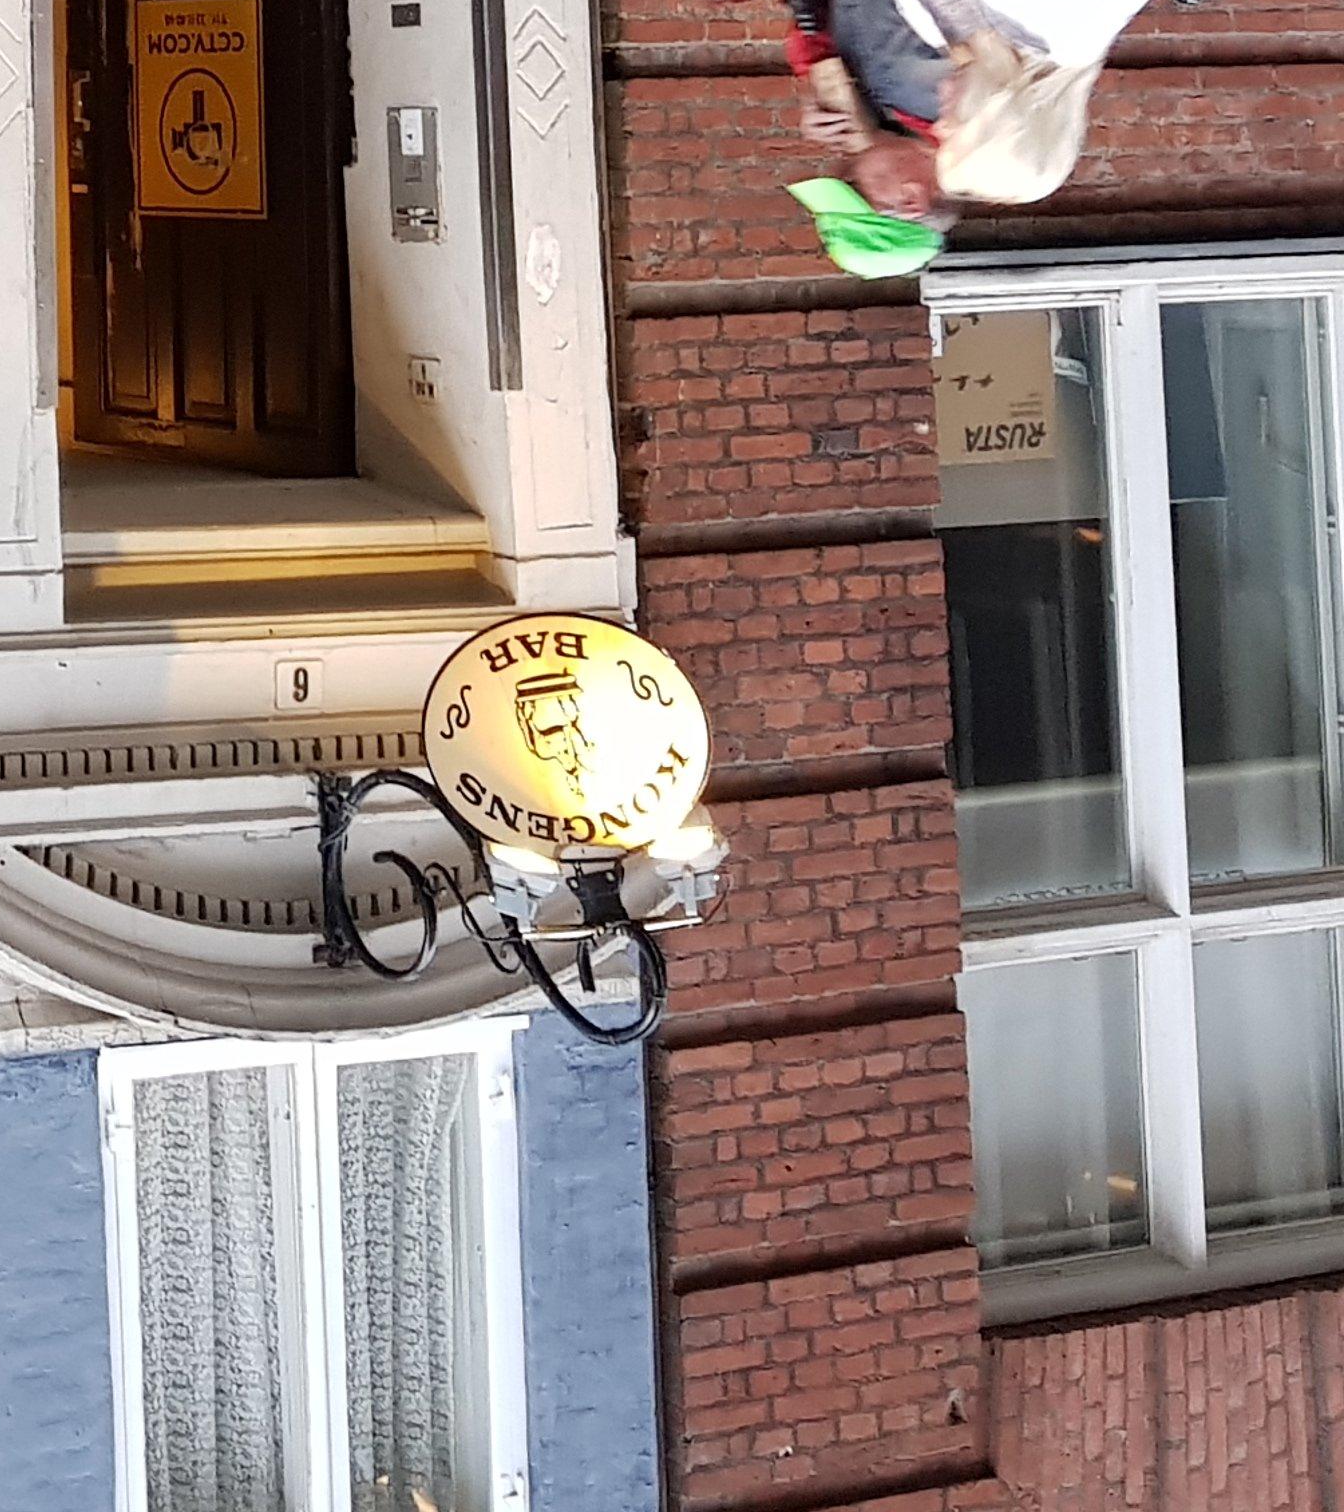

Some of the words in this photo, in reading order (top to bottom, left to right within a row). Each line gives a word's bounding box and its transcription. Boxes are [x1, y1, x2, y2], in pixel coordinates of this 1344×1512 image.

[148, 32, 244, 55] CCTV.COM
[964, 421, 1046, 453] RUSTA
[478, 631, 588, 673] BAR
[293, 667, 308, 703] 6
[455, 744, 689, 843] KONGENS
